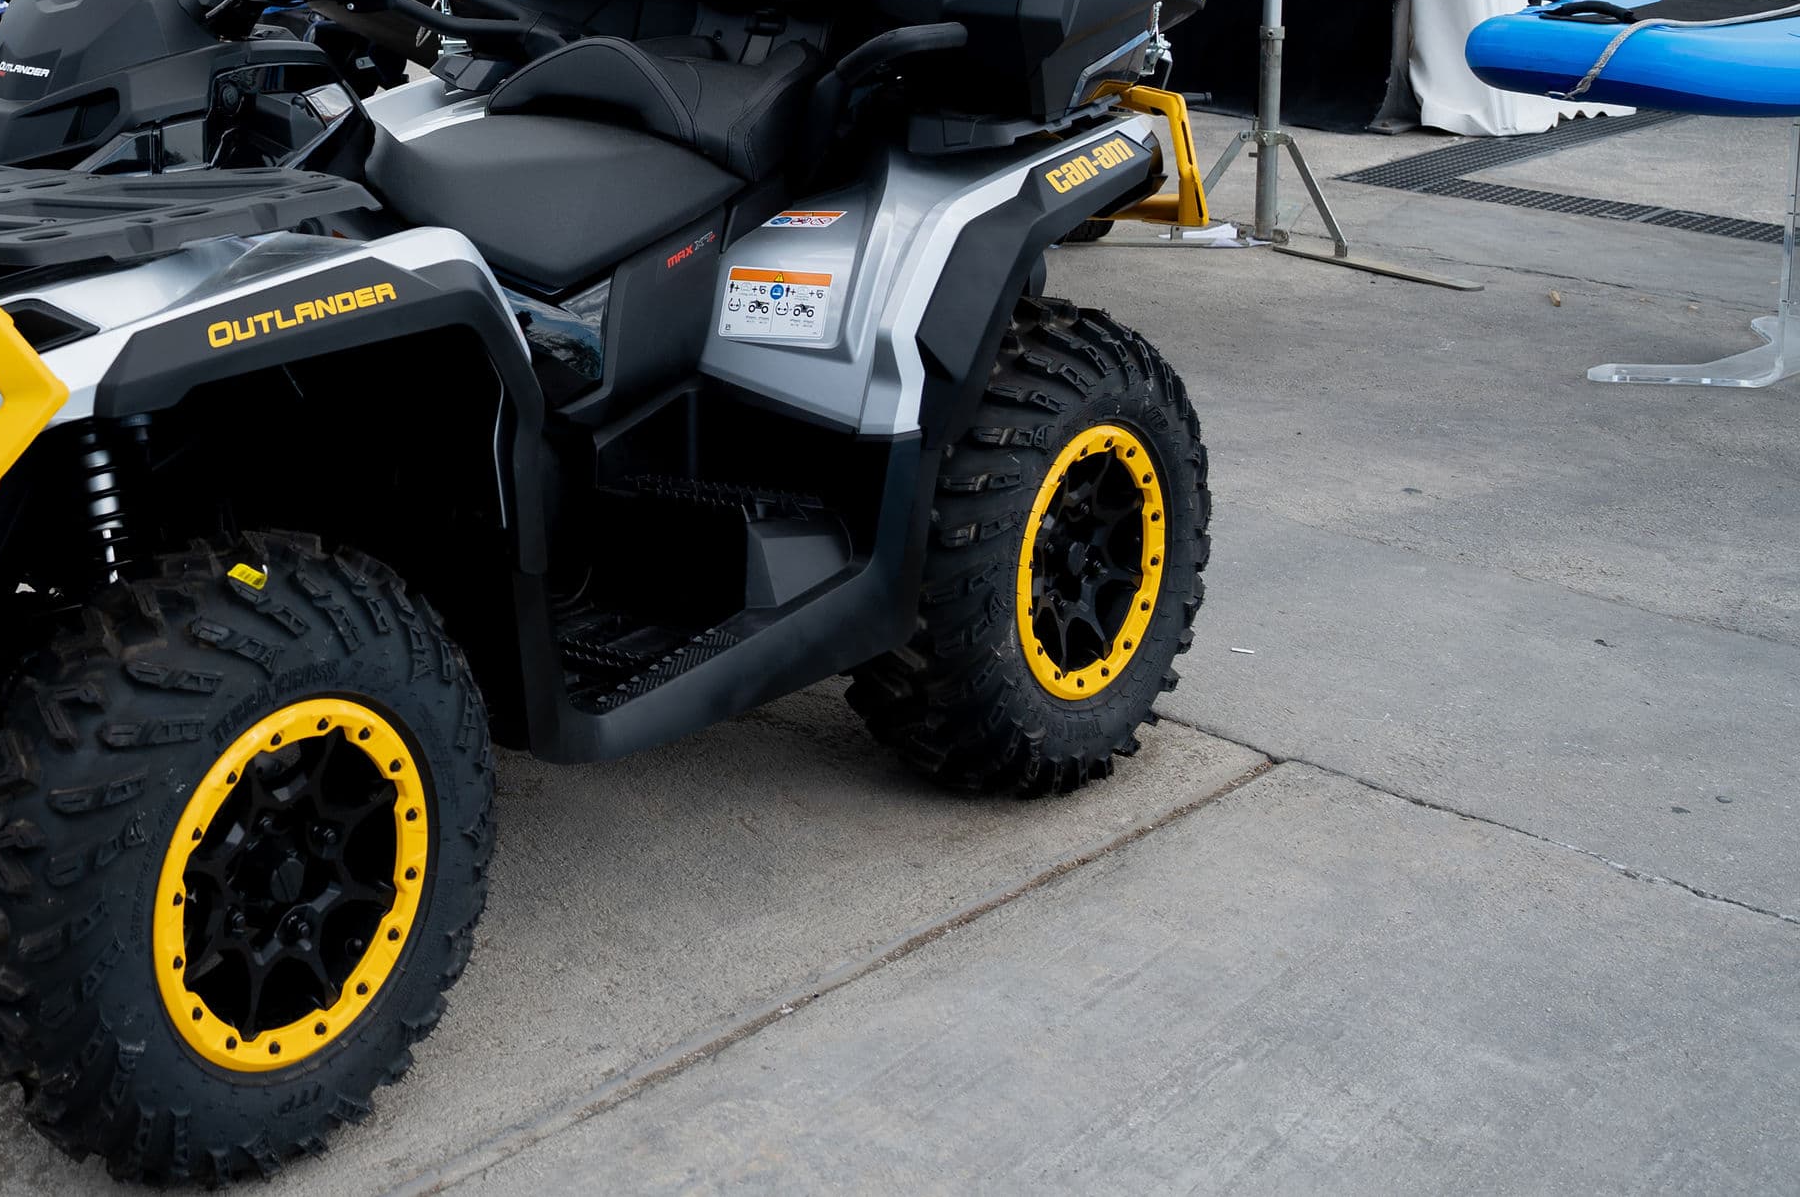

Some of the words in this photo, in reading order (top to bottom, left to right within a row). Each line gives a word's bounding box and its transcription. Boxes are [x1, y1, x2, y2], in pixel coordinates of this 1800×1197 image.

[1044, 137, 1136, 194] can-am
[666, 245, 694, 270] MAX
[207, 282, 398, 349] OUTLANDER
